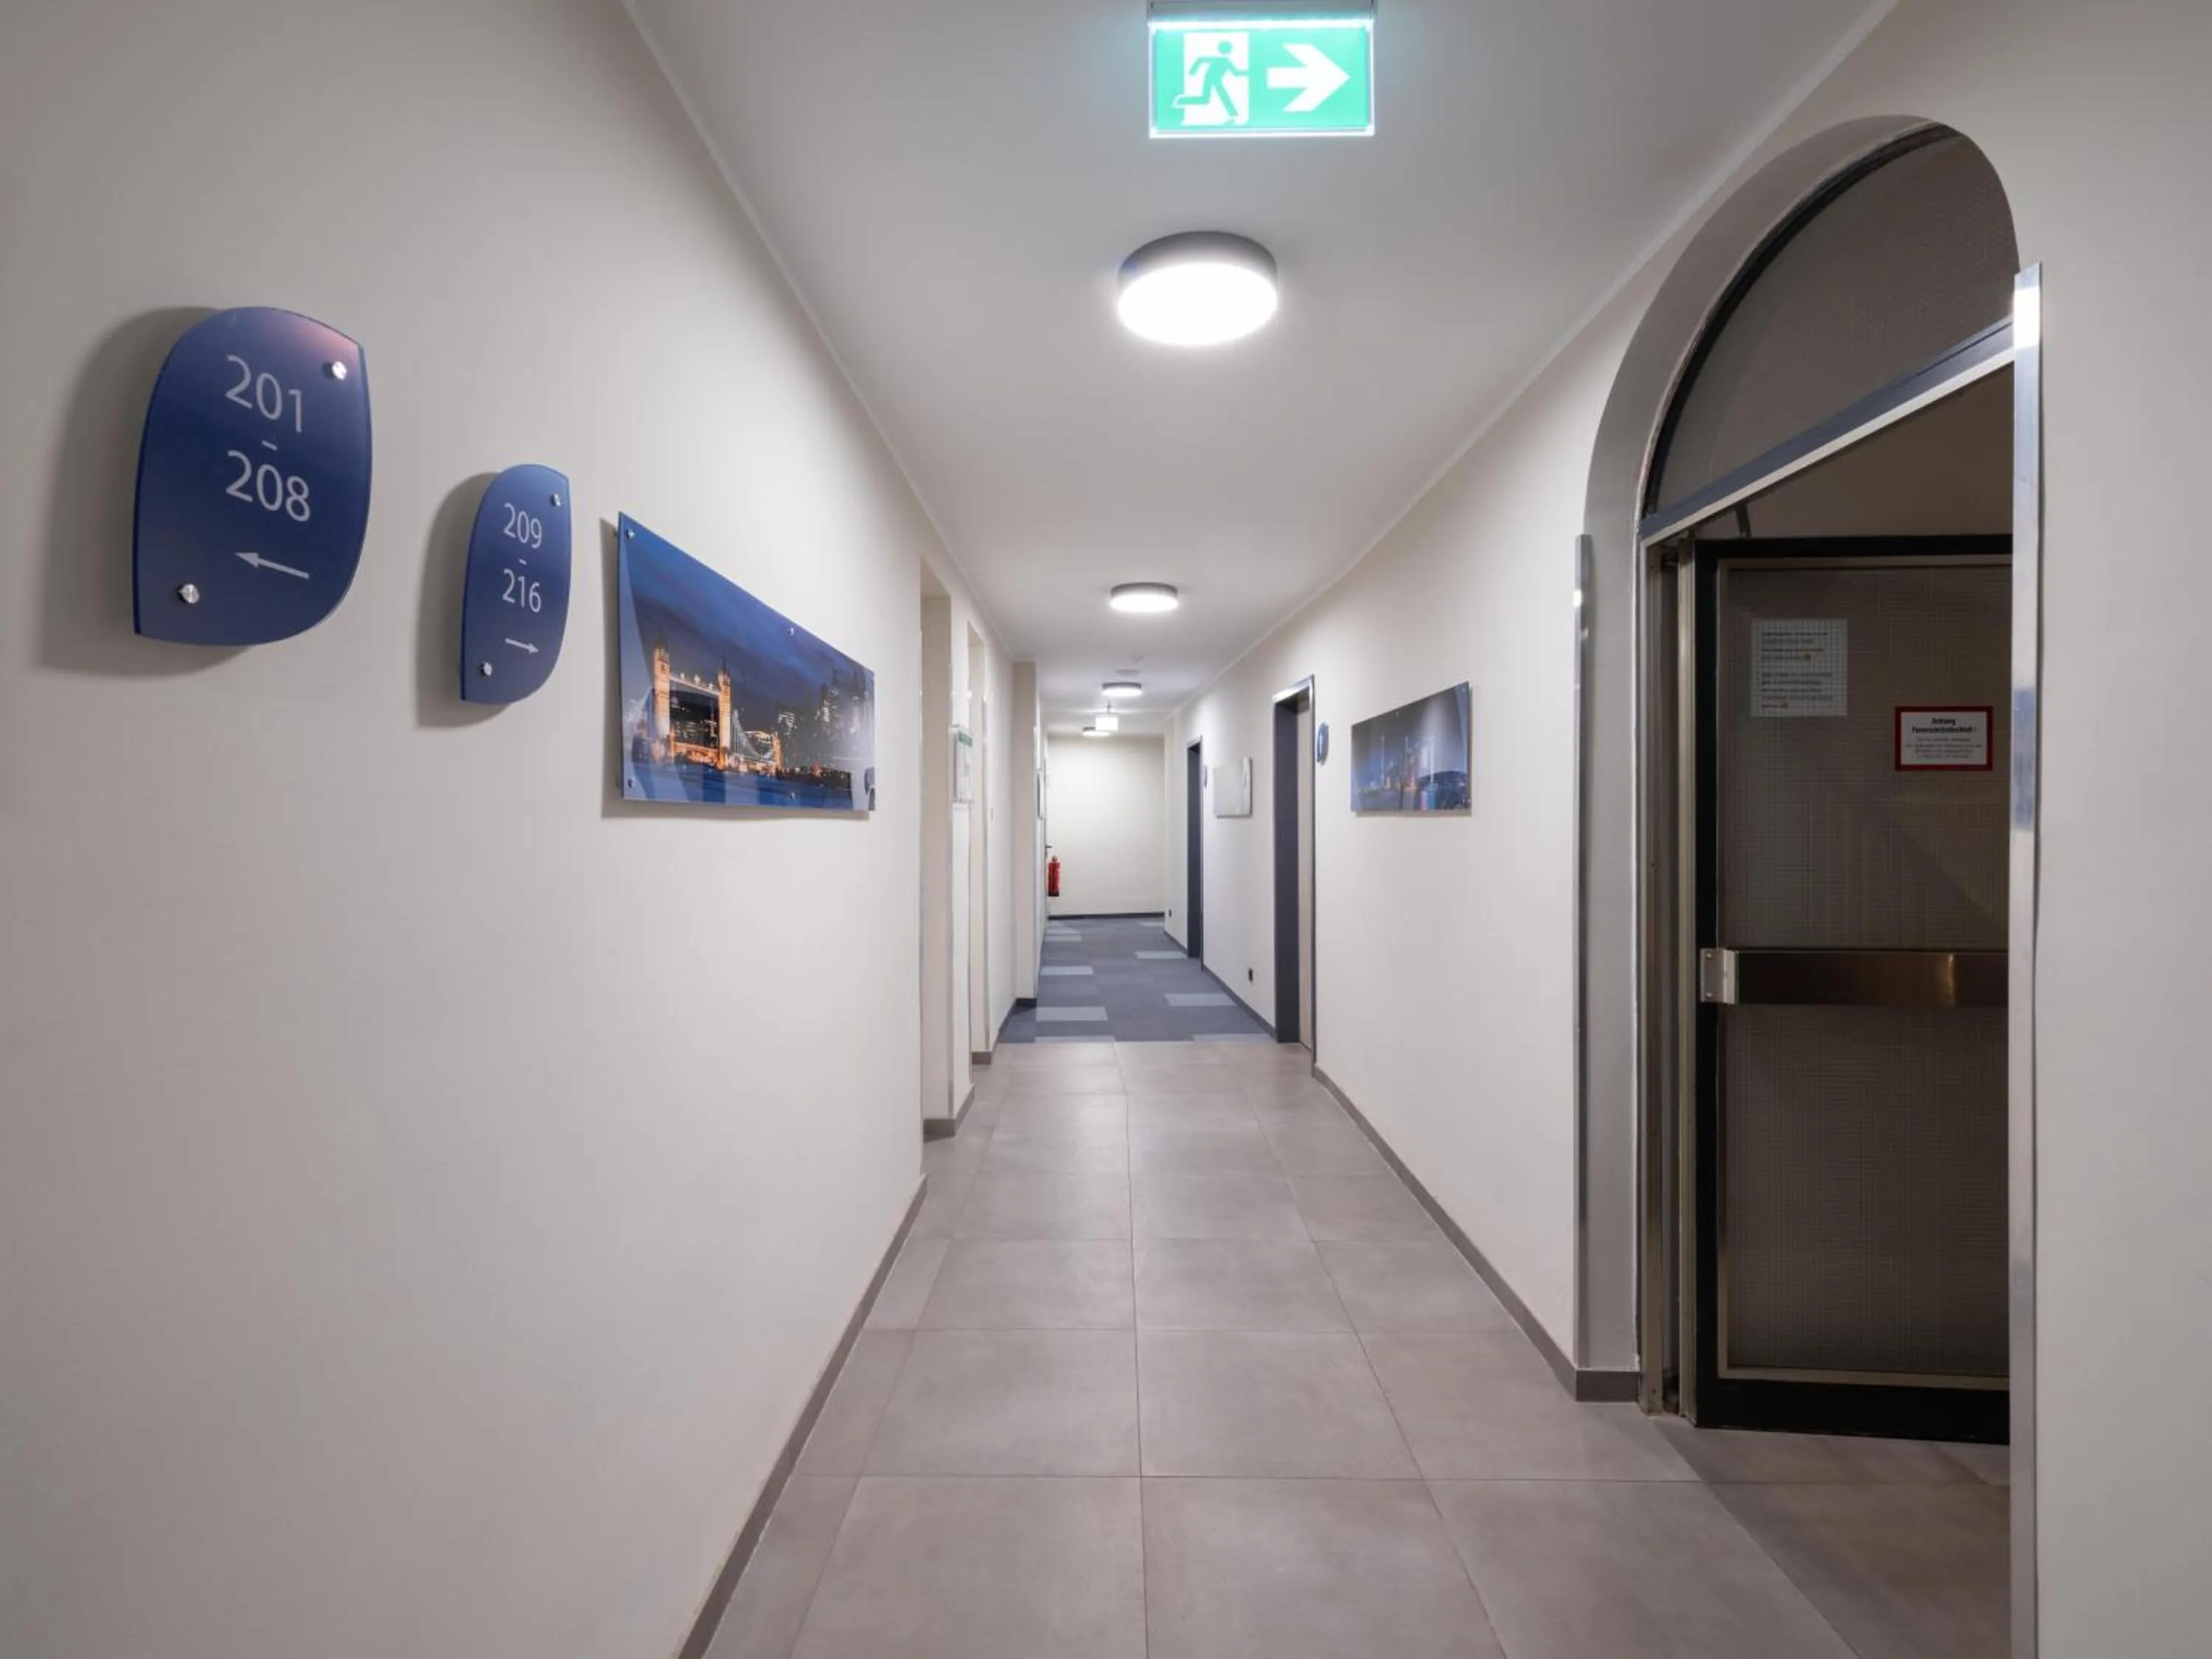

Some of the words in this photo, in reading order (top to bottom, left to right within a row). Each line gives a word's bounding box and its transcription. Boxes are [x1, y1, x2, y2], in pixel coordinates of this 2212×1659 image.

[226, 355, 304, 432] 201
[226, 450, 311, 522] 208
[503, 501, 543, 550] 209
[501, 568, 541, 613] 216
